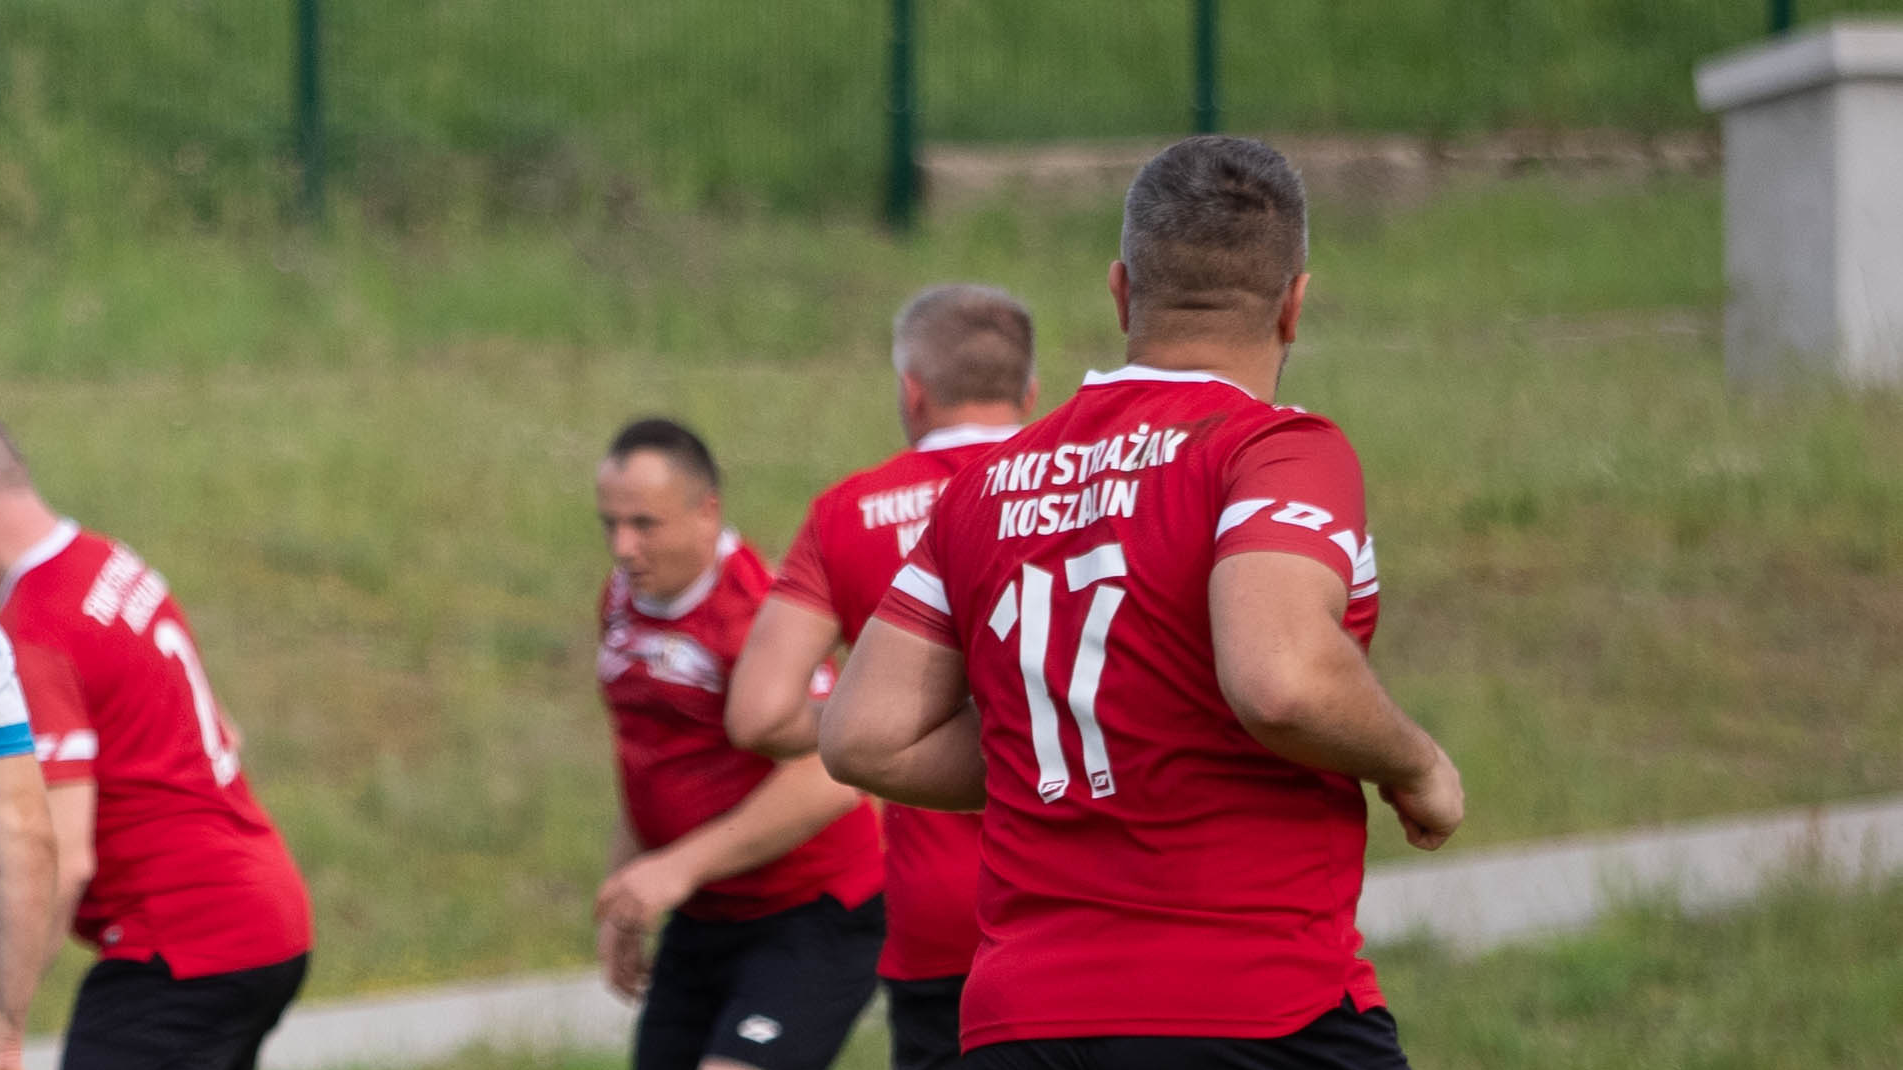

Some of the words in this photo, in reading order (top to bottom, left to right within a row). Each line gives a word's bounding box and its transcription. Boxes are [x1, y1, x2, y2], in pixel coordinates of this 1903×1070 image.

[980, 452, 1053, 499] TKKF
[1050, 423, 1189, 486] STRAŻAK
[998, 479, 1139, 540] KOSZALIN
[988, 543, 1127, 803] 17
